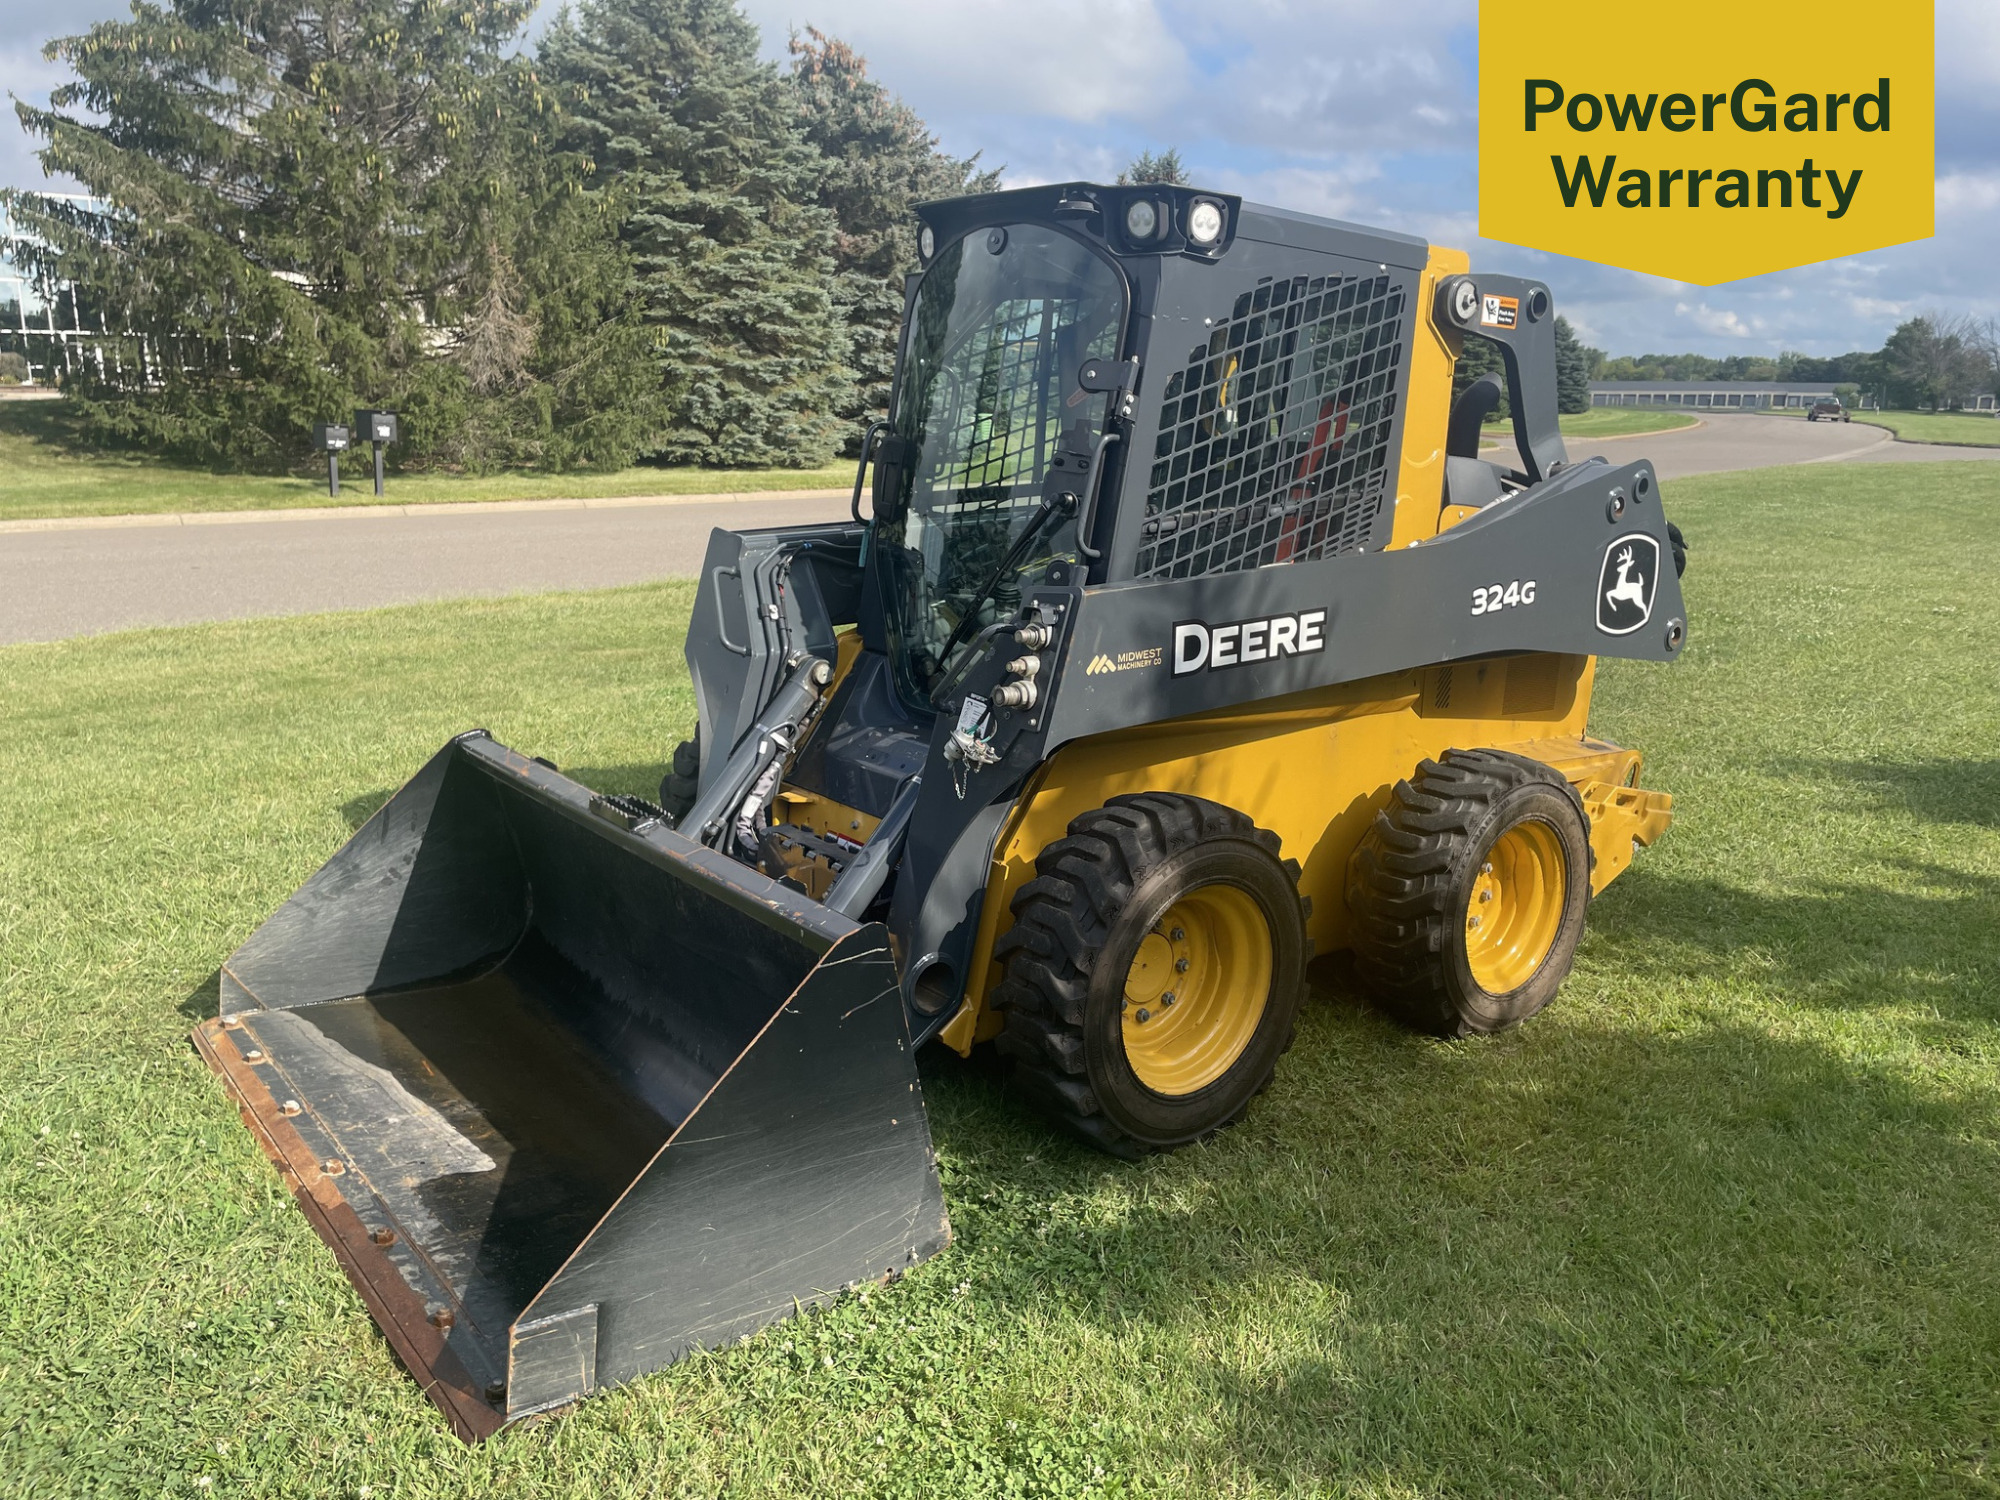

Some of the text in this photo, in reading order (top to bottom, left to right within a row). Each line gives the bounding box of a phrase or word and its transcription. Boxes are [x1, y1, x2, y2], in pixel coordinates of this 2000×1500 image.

[1470, 580, 1536, 616] 324G
[1117, 647, 1163, 663] MIDWEST
[1173, 610, 1326, 676] DEERE
[1117, 658, 1162, 671] MACHINERY CO
